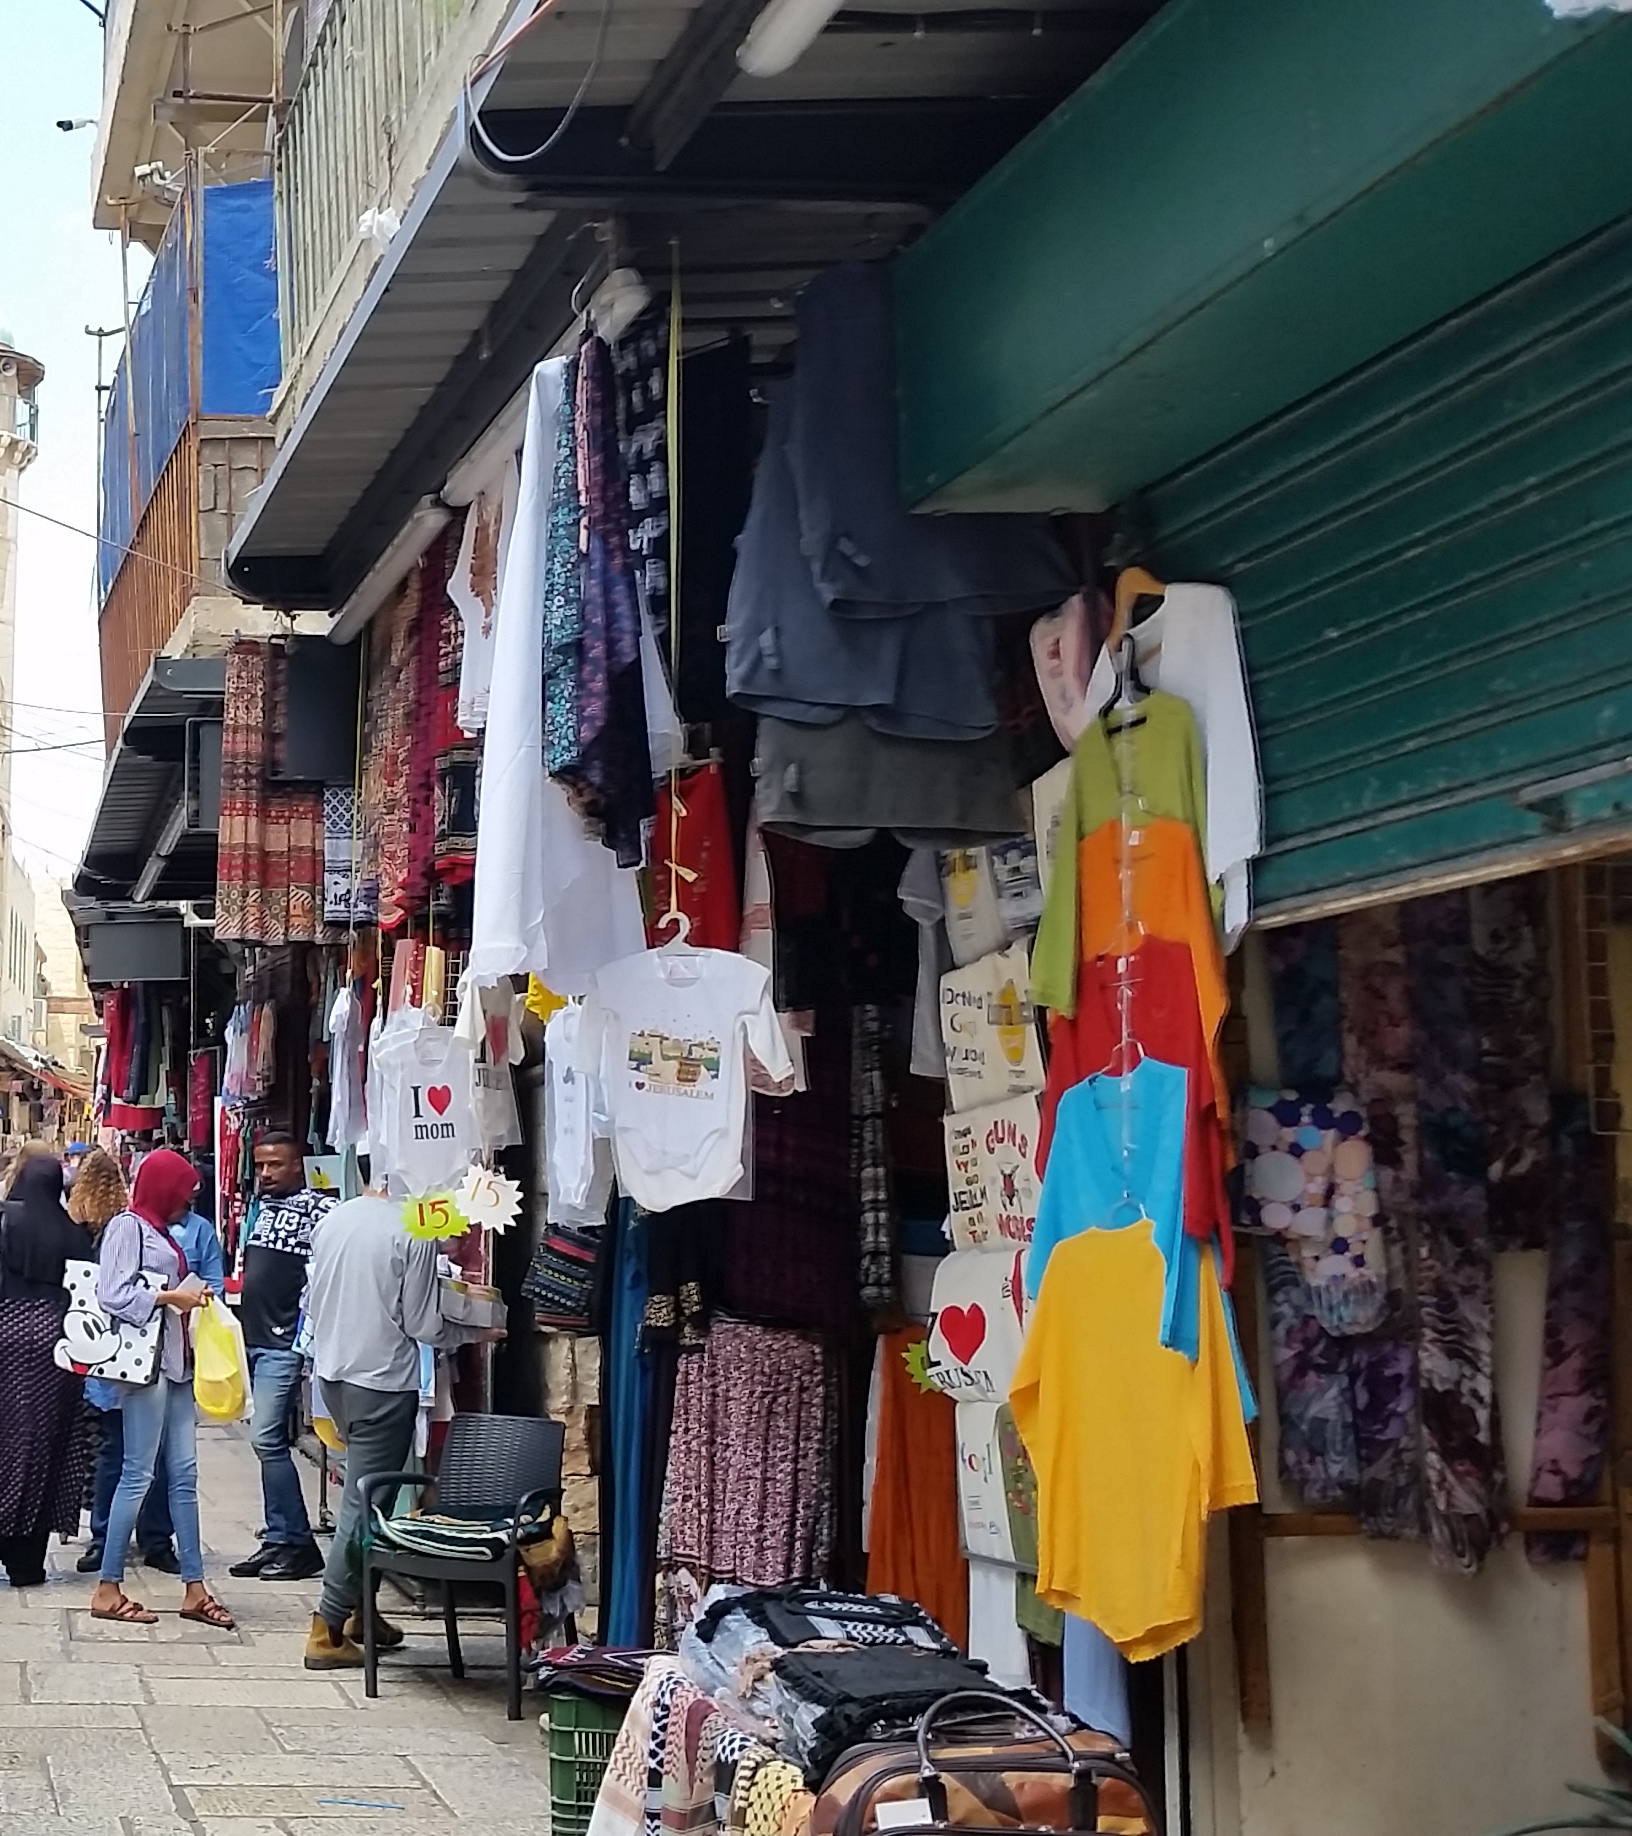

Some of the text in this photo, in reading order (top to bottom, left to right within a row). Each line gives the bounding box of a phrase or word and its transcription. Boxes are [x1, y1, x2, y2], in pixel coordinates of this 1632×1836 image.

[411, 1085, 424, 1119] I
[645, 1085, 715, 1101] JERUSALEM
[414, 1121, 456, 1140] mom
[471, 1176, 508, 1208] 15
[274, 1209, 301, 1232] 03
[418, 1199, 450, 1230] 15
